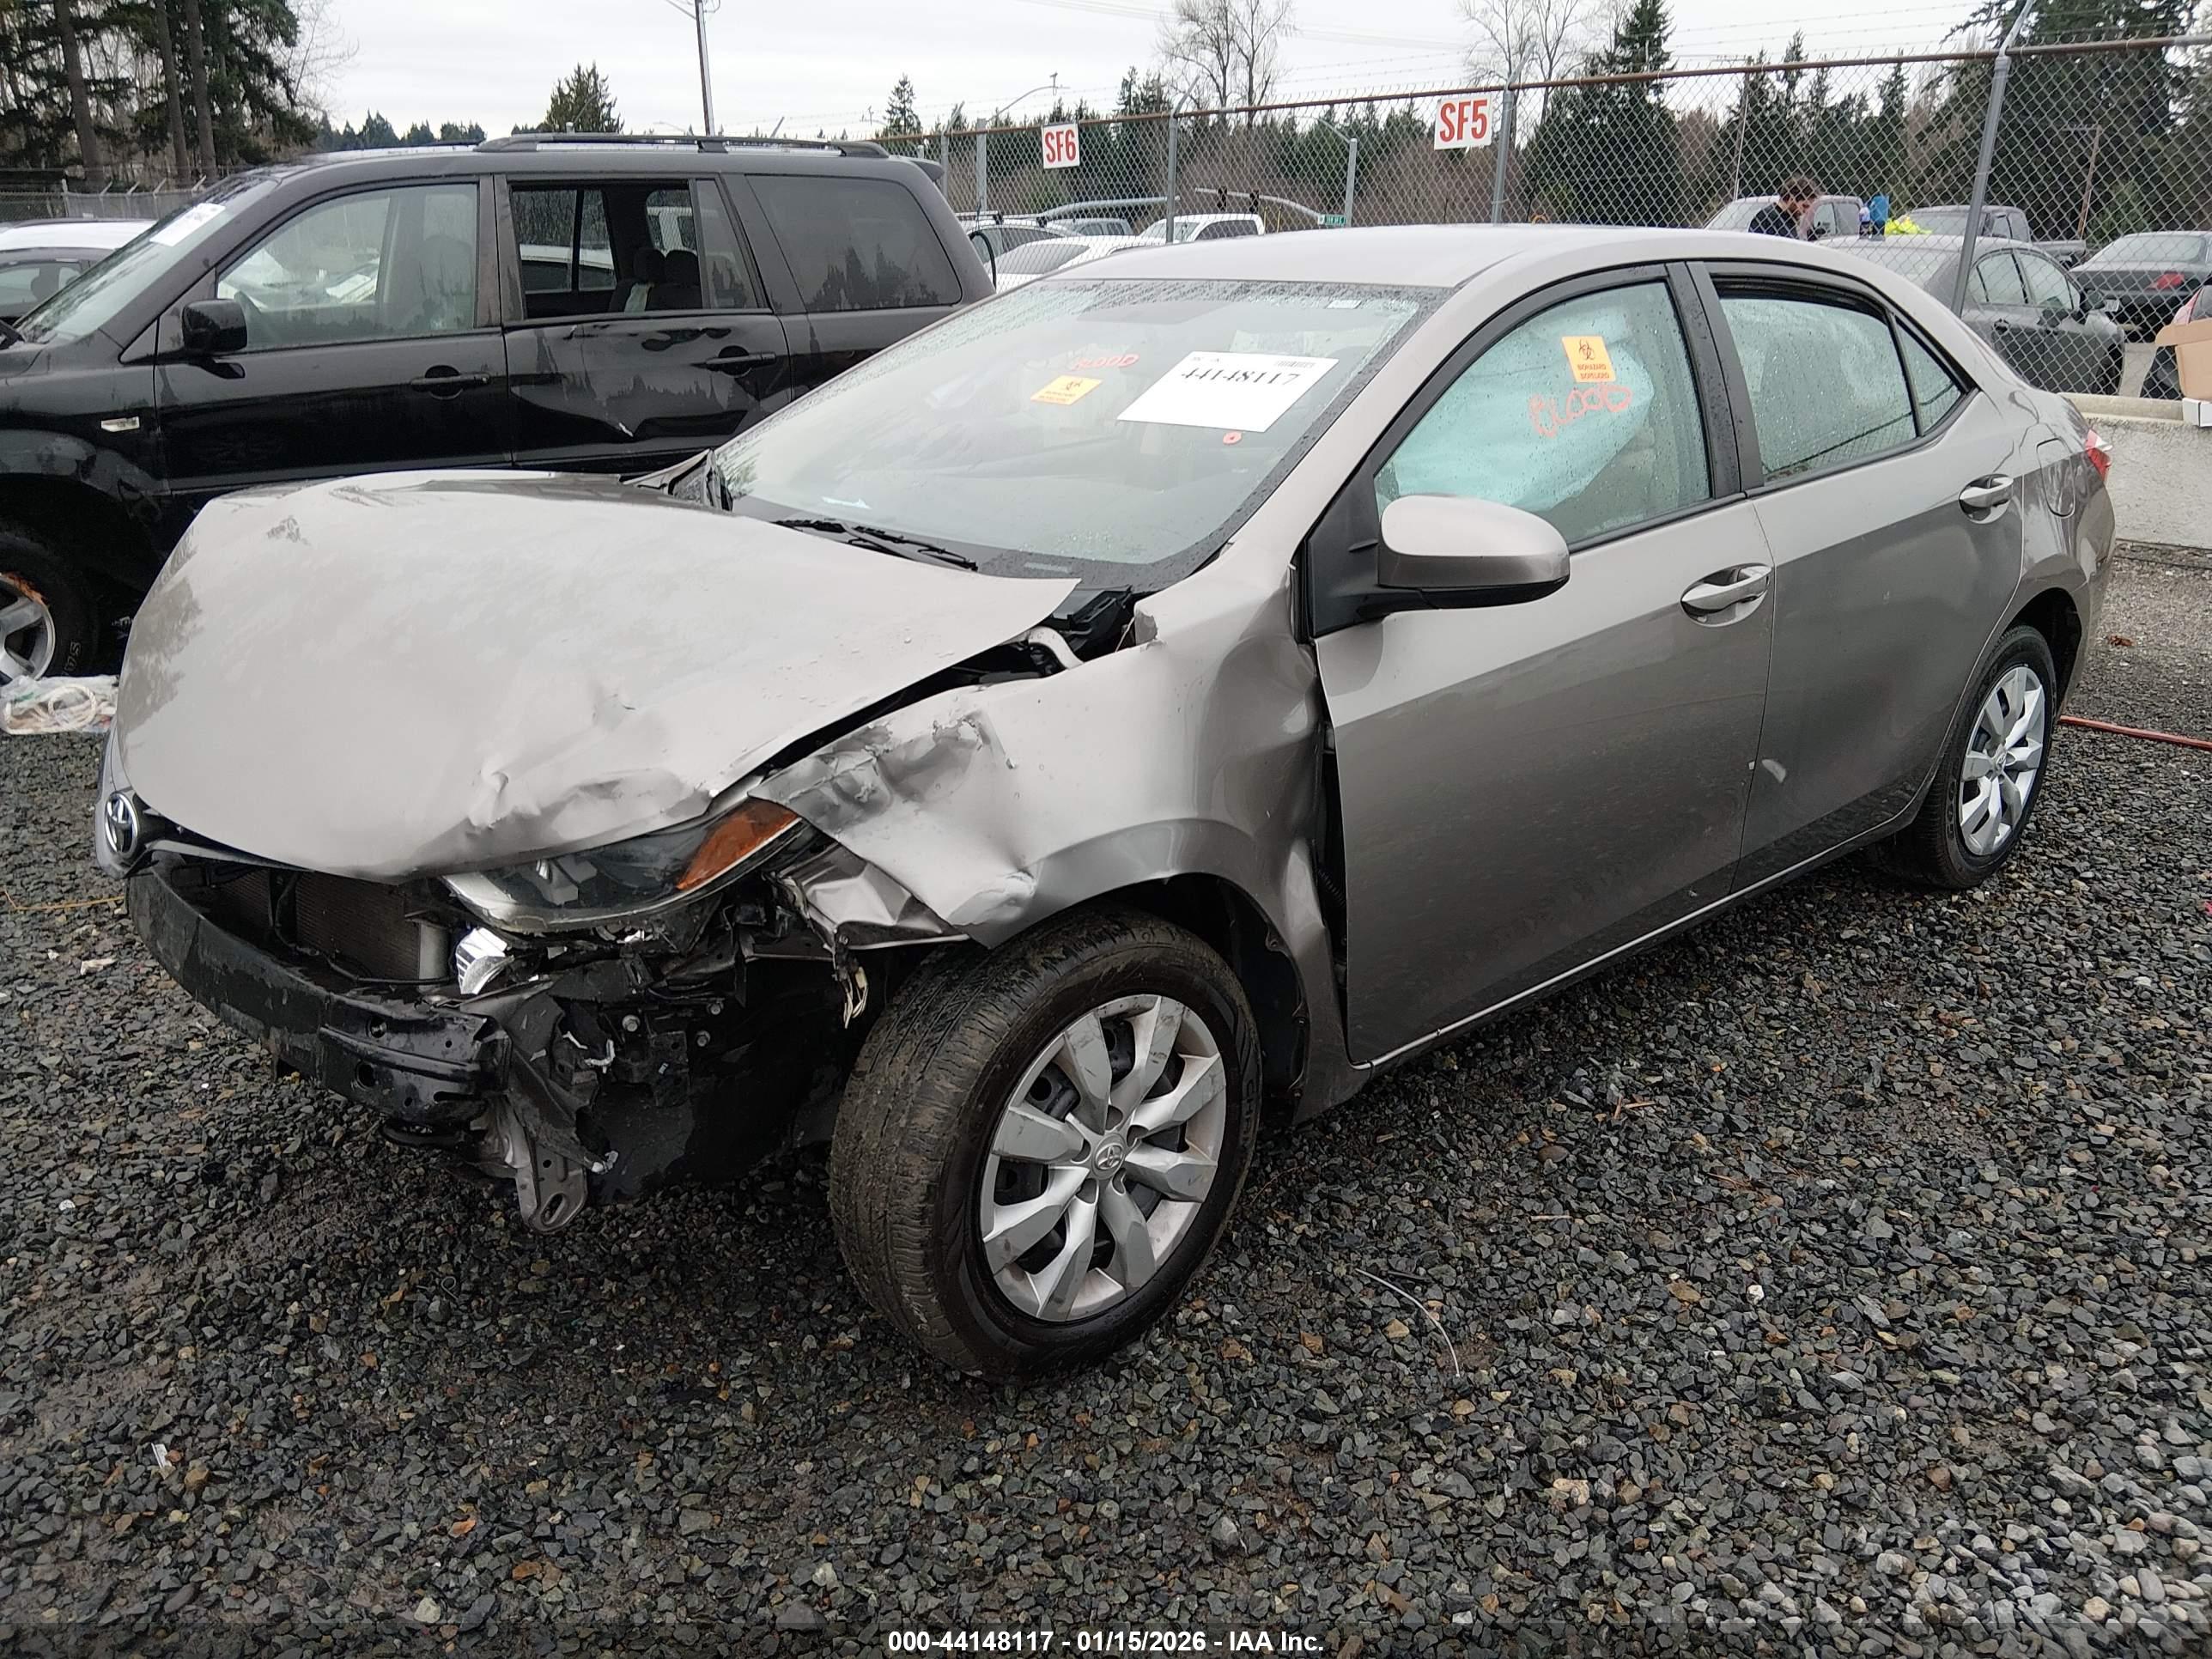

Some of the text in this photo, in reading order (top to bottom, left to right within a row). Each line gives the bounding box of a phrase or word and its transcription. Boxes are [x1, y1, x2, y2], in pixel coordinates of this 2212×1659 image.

[1440, 99, 1487, 143] SF5
[1044, 129, 1076, 163] SF6
[1181, 367, 1302, 386] 44148117
